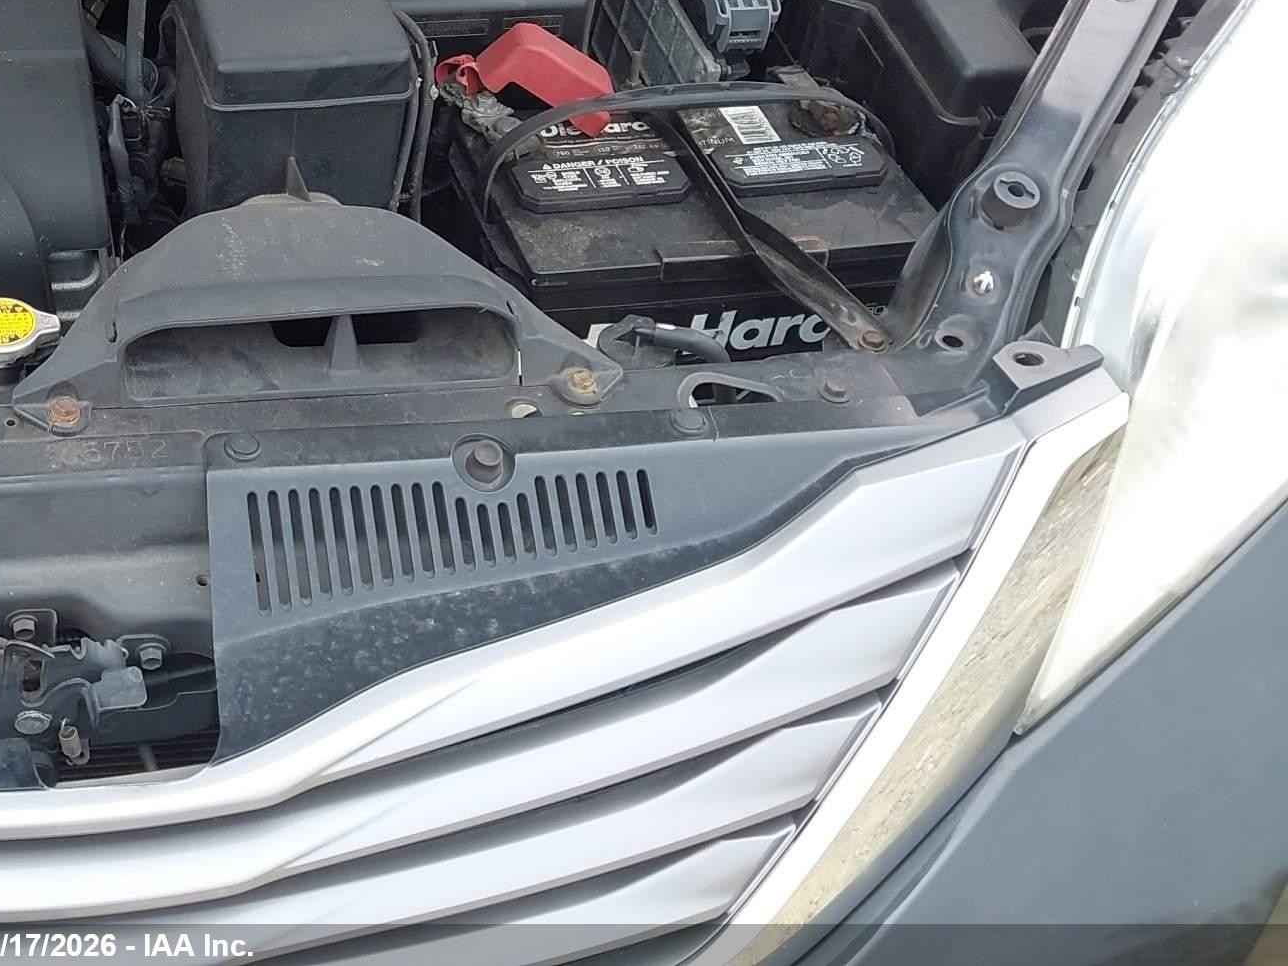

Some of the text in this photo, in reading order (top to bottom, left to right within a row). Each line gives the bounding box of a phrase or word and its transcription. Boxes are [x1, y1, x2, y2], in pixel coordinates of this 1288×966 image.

[541, 121, 651, 138] Dieard
[696, 135, 736, 147] ATINUM
[552, 161, 594, 170] DANGER
[604, 156, 644, 166] POISON
